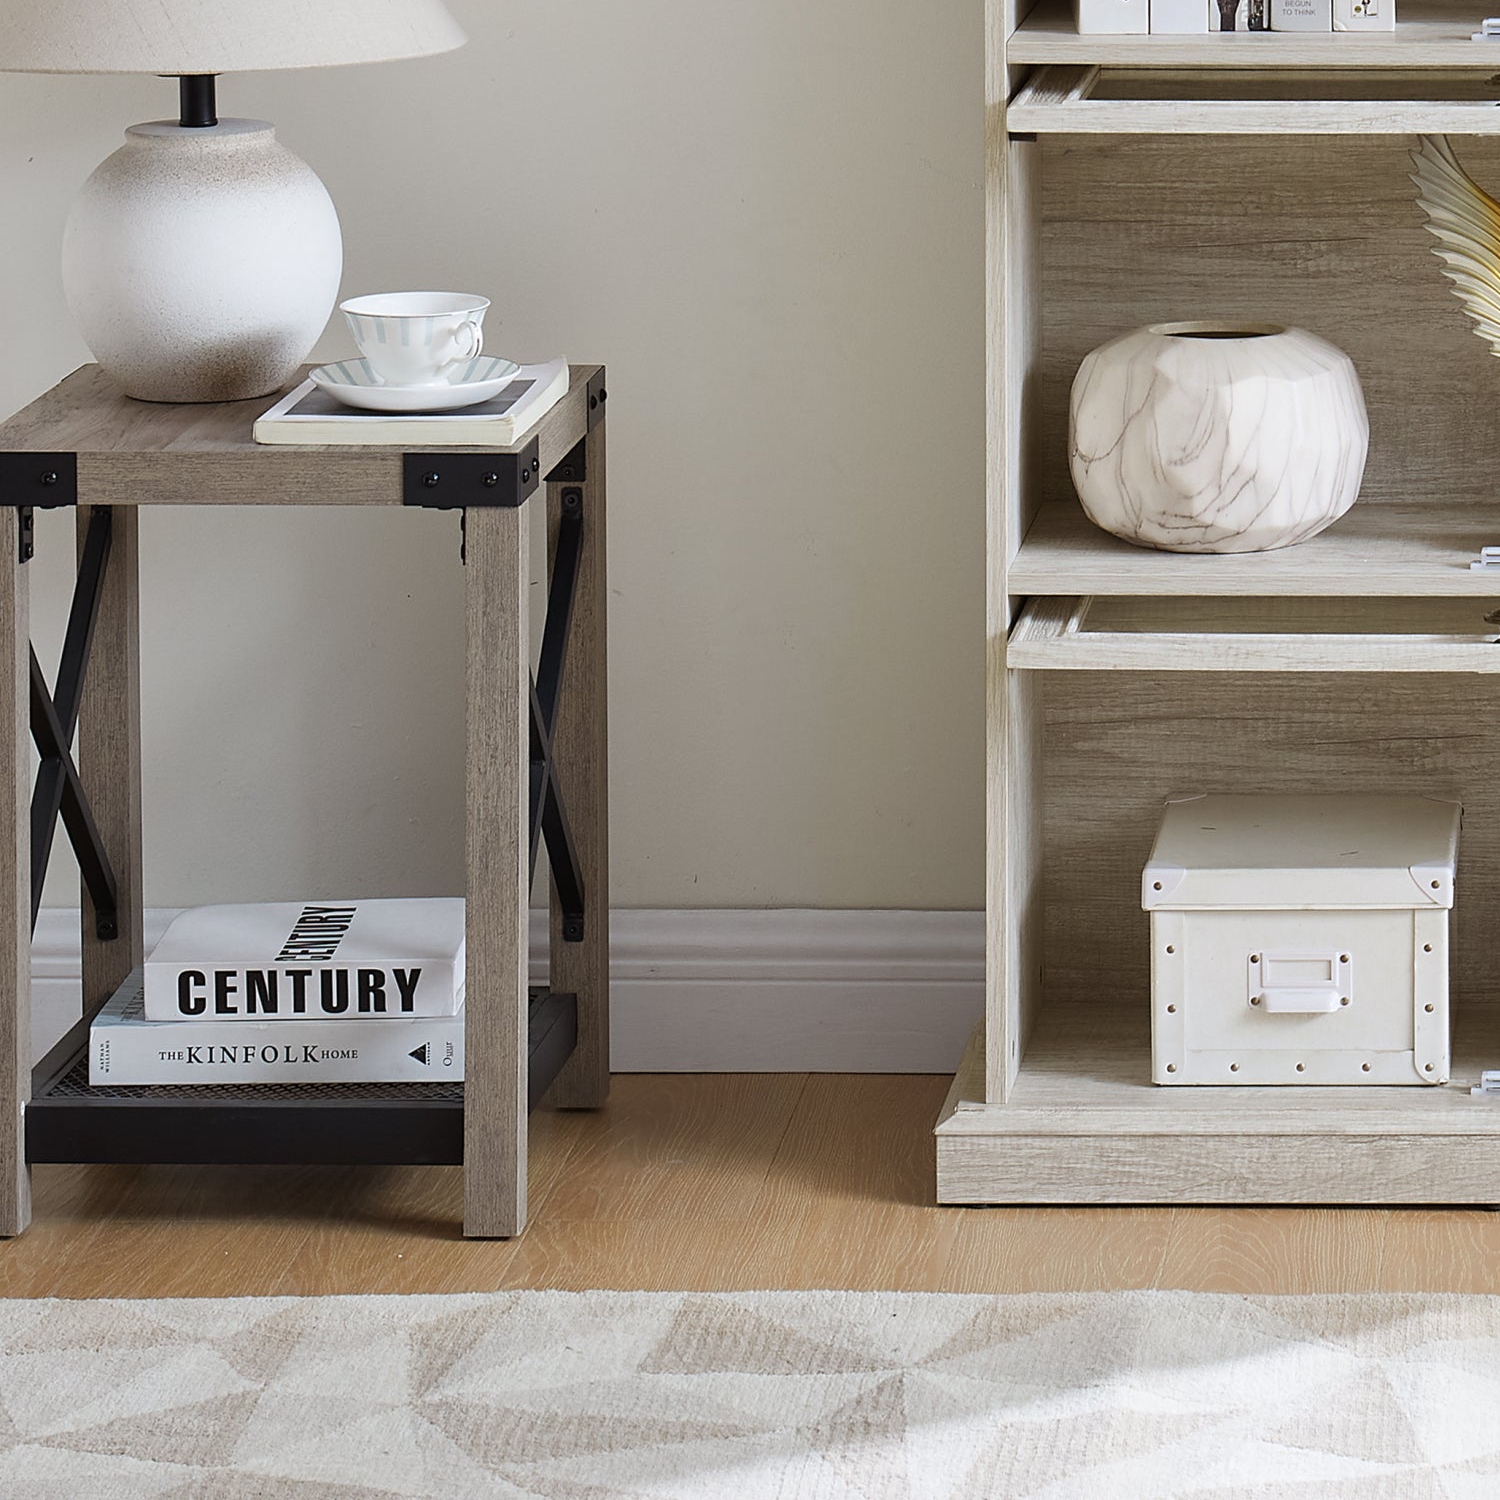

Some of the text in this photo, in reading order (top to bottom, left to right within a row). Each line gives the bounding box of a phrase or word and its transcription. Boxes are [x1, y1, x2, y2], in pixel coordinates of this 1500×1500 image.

[273, 906, 358, 961] CENTURY
[177, 968, 424, 1016] CENTURY
[159, 1044, 359, 1064] THE KINFOLK HOME
